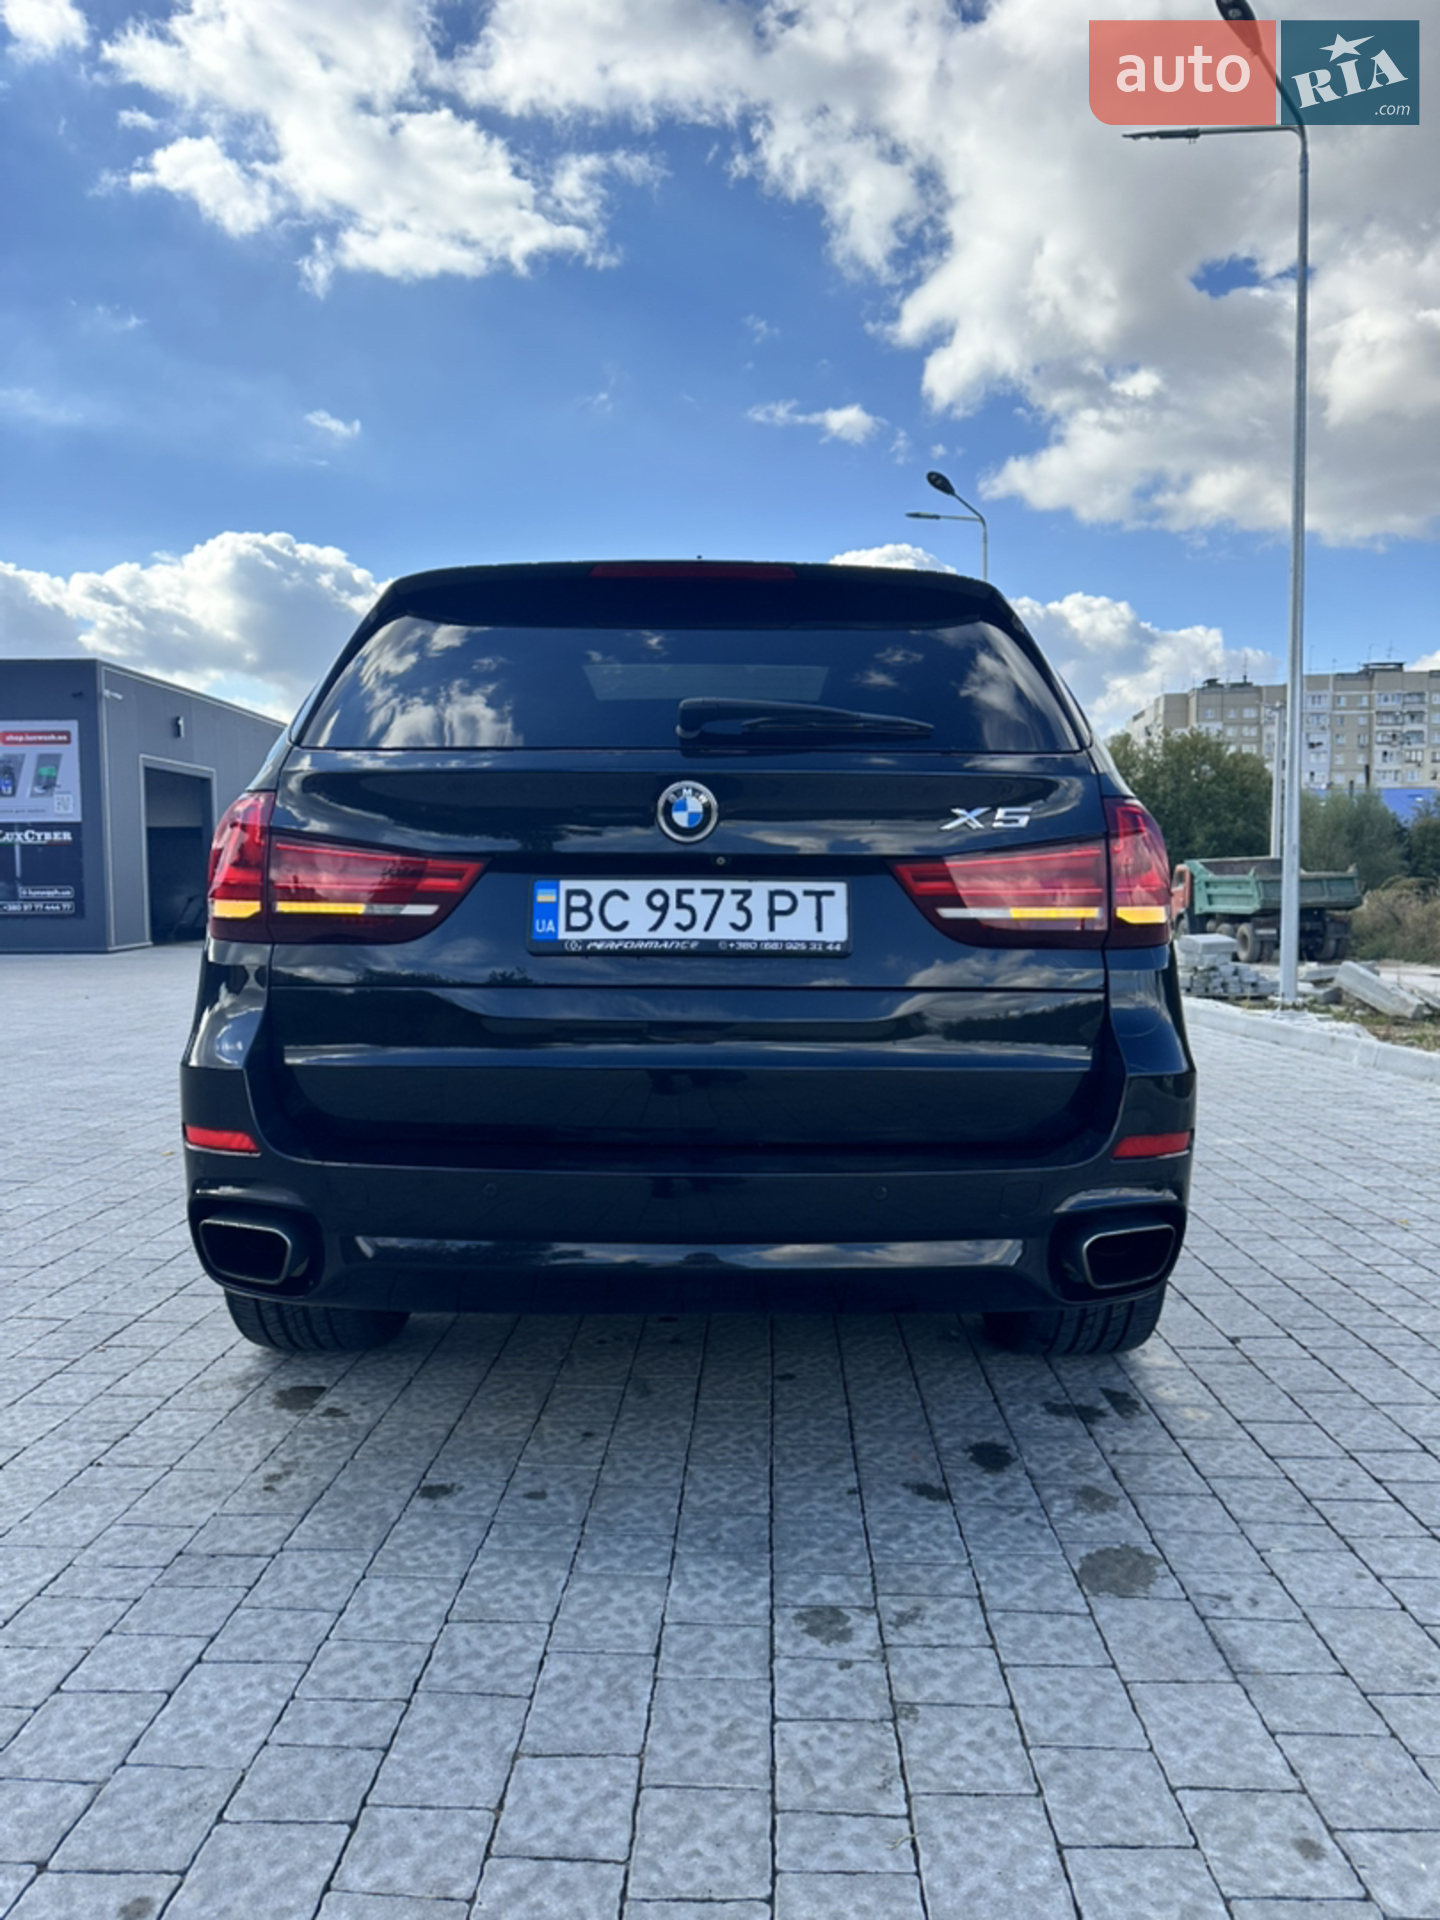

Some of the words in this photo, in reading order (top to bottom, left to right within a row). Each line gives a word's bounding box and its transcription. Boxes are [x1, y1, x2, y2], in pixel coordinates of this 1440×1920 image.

[940, 806, 1033, 830] X5
[564, 888, 630, 932] BC
[645, 888, 753, 932] 9573
[768, 889, 836, 932] PT
[535, 918, 555, 933] UA
[586, 940, 700, 950] PERFORMANCE
[826, 942, 842, 951] 44
